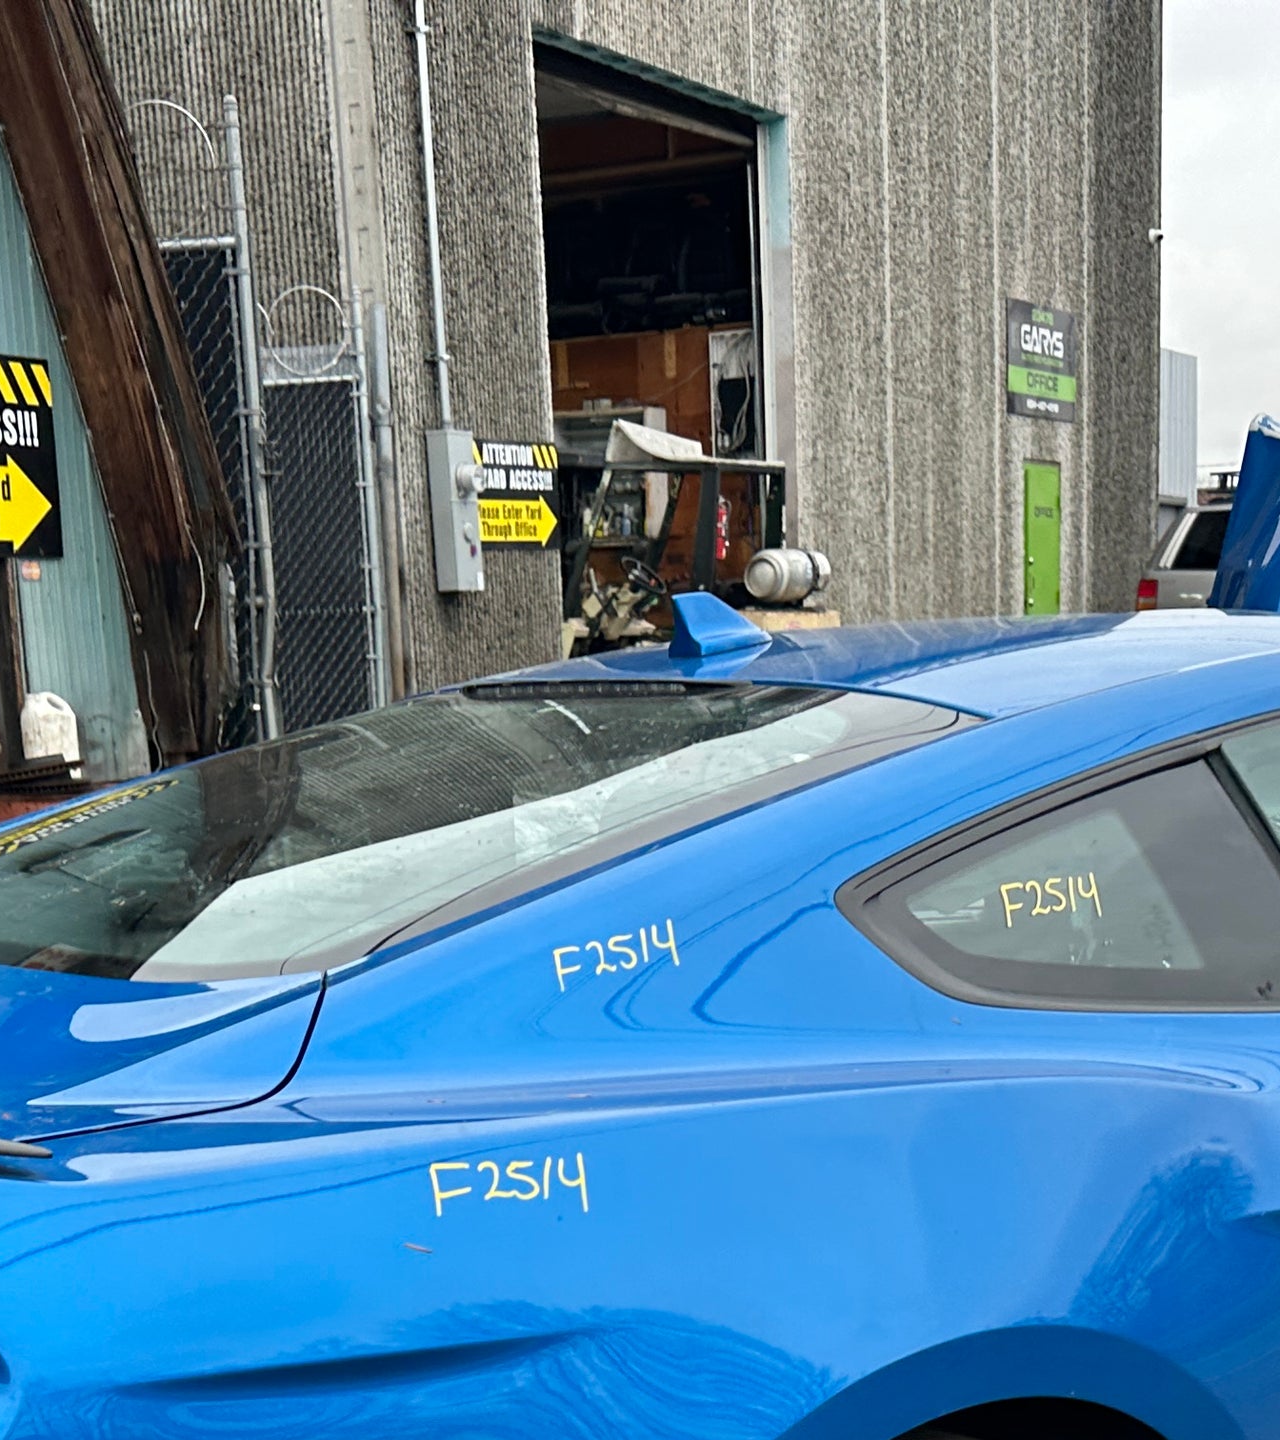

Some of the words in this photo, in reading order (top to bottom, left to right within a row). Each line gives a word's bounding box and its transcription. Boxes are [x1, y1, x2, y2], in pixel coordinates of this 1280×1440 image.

[482, 442, 534, 467] ATTENTION
[482, 521, 512, 540] Through
[514, 522, 538, 537] Office
[502, 505, 523, 520] Enter
[525, 505, 542, 521] Yard
[999, 871, 1102, 928] F2514
[552, 918, 680, 993] F2514
[429, 1152, 589, 1217] F2514
